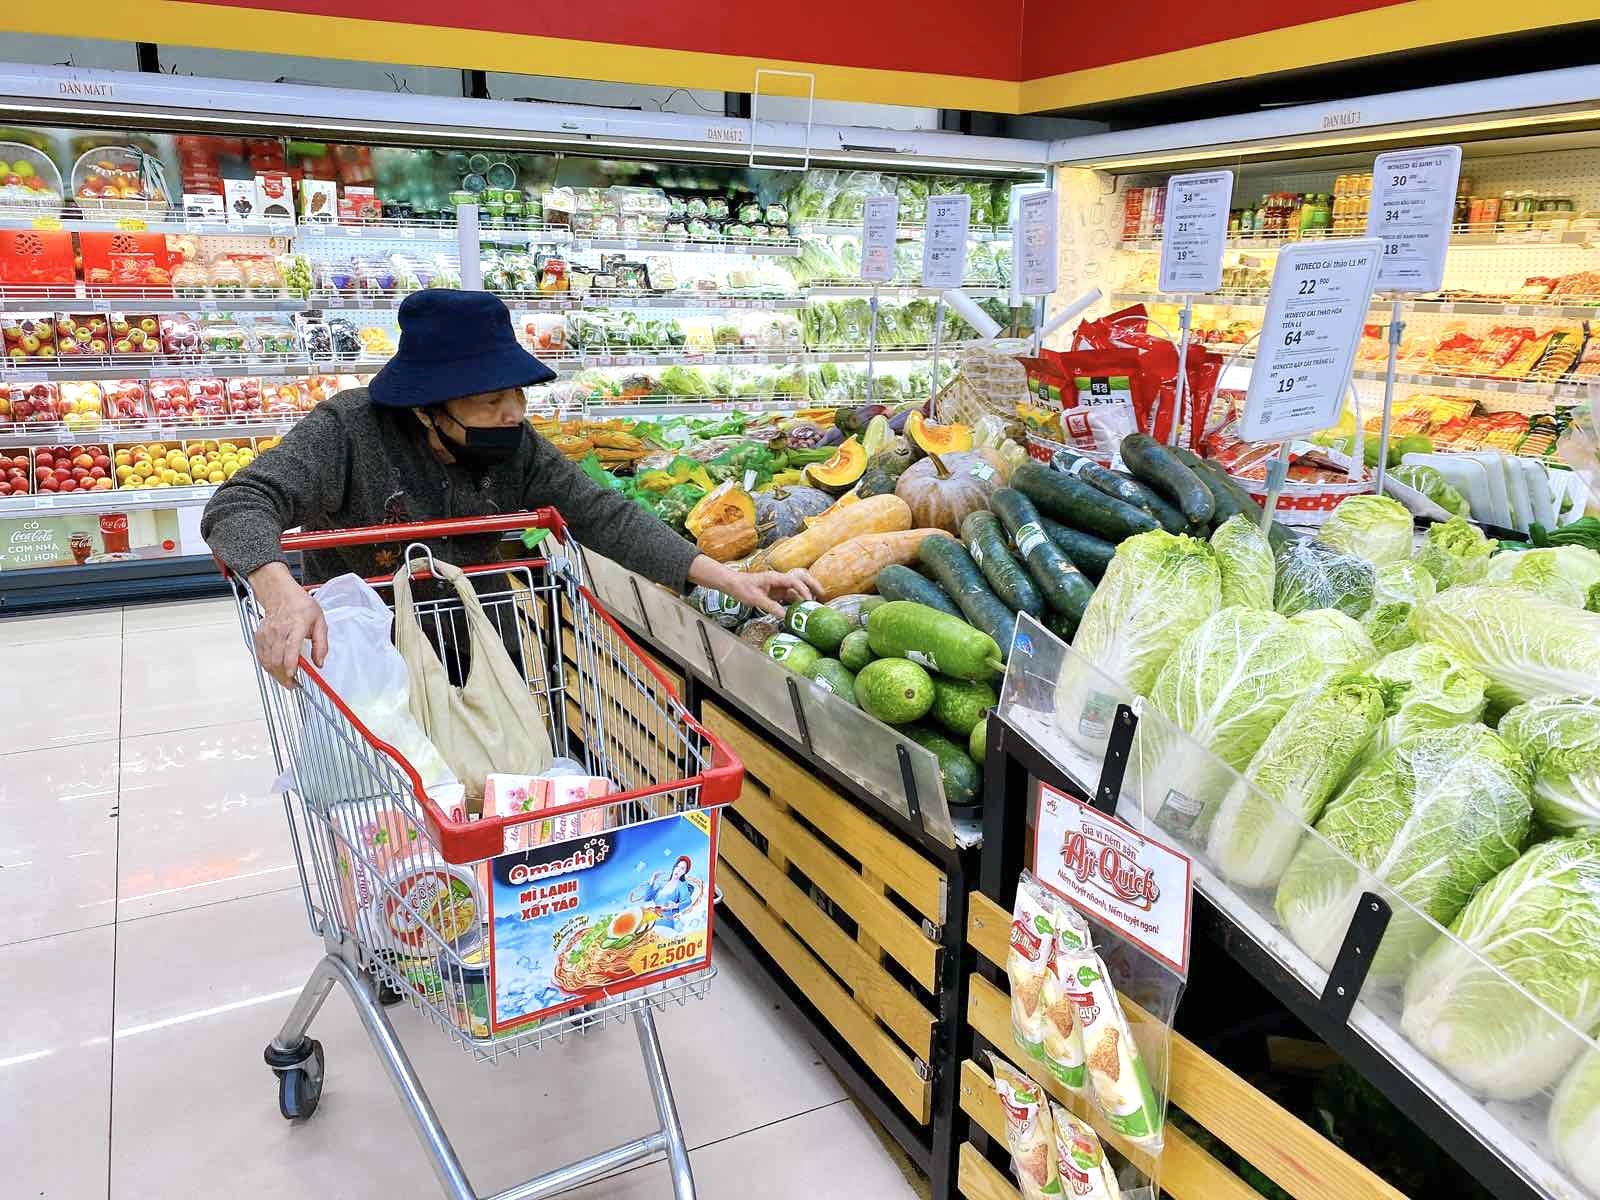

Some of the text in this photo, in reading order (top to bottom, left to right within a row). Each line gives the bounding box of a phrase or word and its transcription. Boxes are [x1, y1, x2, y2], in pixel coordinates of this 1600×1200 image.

[1391, 175, 1408, 187] 30
[1181, 193, 1193, 204] 34
[1385, 210, 1399, 221] 34
[1178, 222, 1188, 232] 21
[1383, 244, 1399, 255] 18
[1177, 250, 1188, 261] 19
[1294, 261, 1321, 271] WINECO
[1298, 279, 1317, 295] 22
[1284, 331, 1302, 346] 64
[1277, 378, 1294, 393] 19
[1082, 823, 1095, 836] Gia
[509, 848, 595, 885] Omachi
